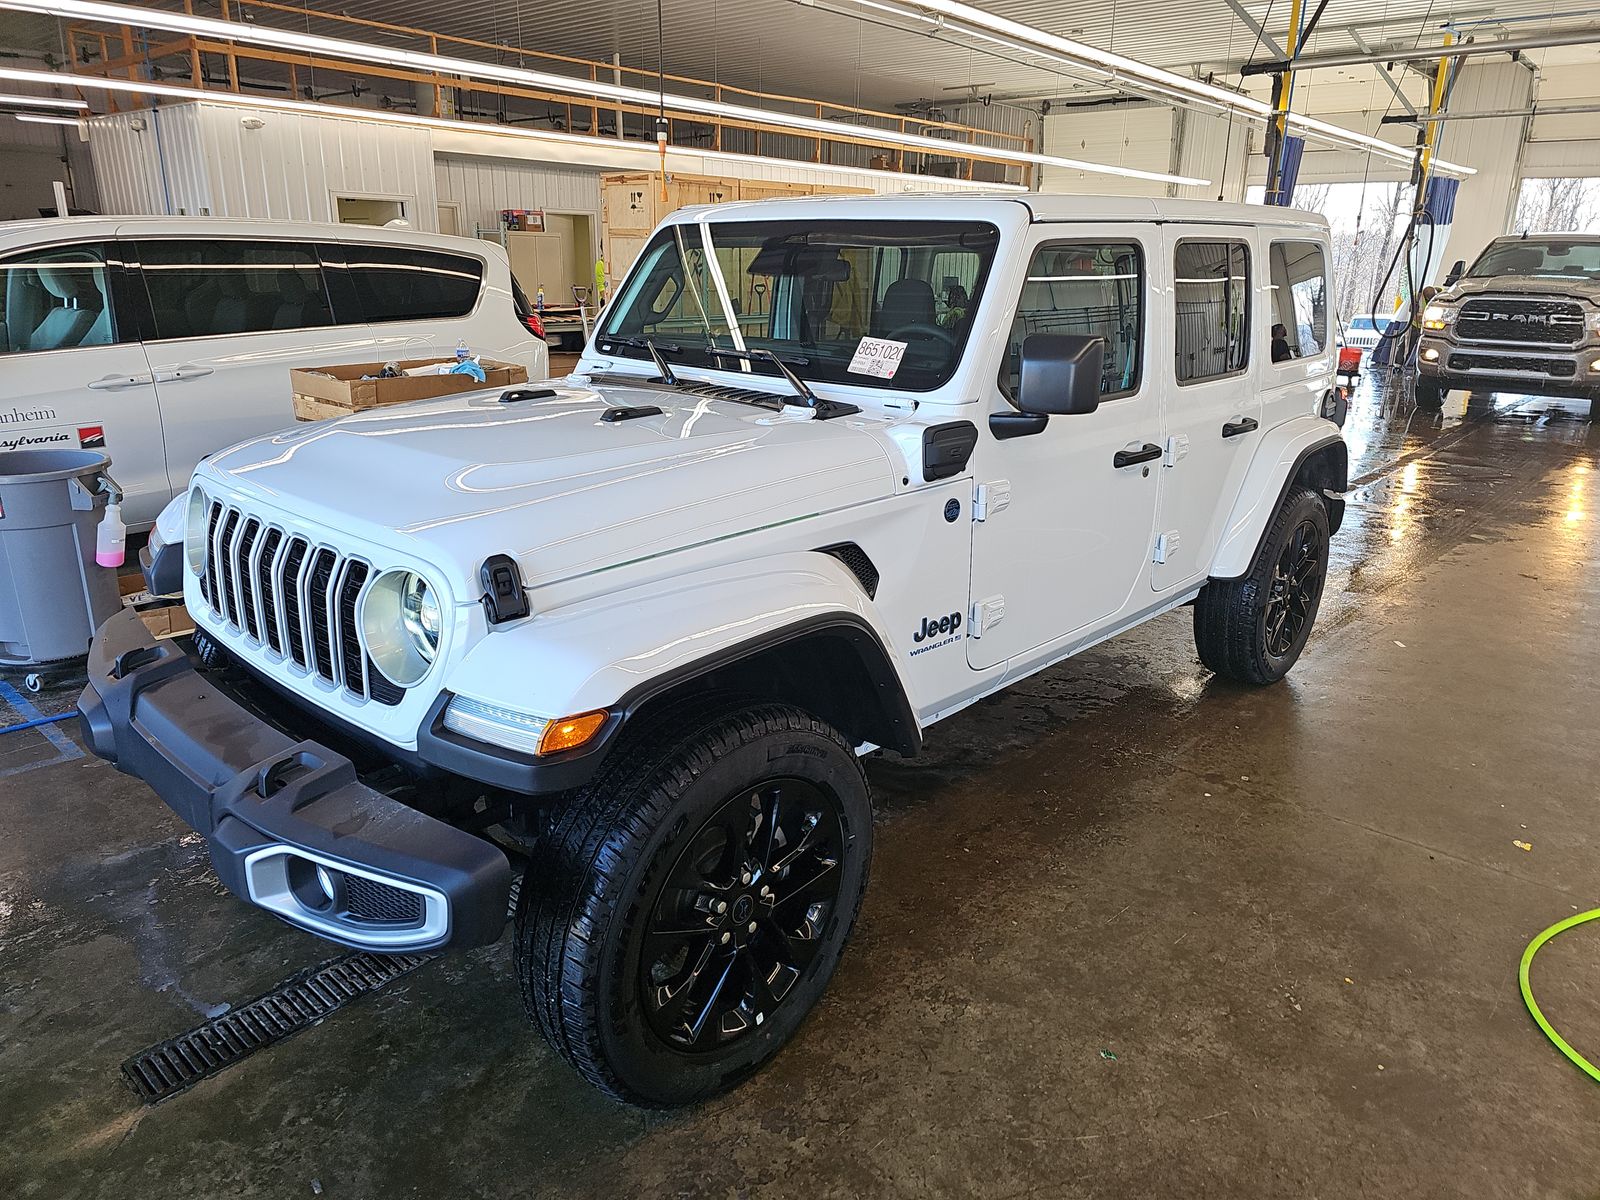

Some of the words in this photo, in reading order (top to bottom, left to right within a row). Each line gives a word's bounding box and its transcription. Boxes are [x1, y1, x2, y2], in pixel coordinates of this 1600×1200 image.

[1492, 313, 1547, 324] RAM
[0, 433, 70, 450] sylvania
[913, 611, 962, 643] Jeep
[909, 637, 954, 657] WRANGLER
